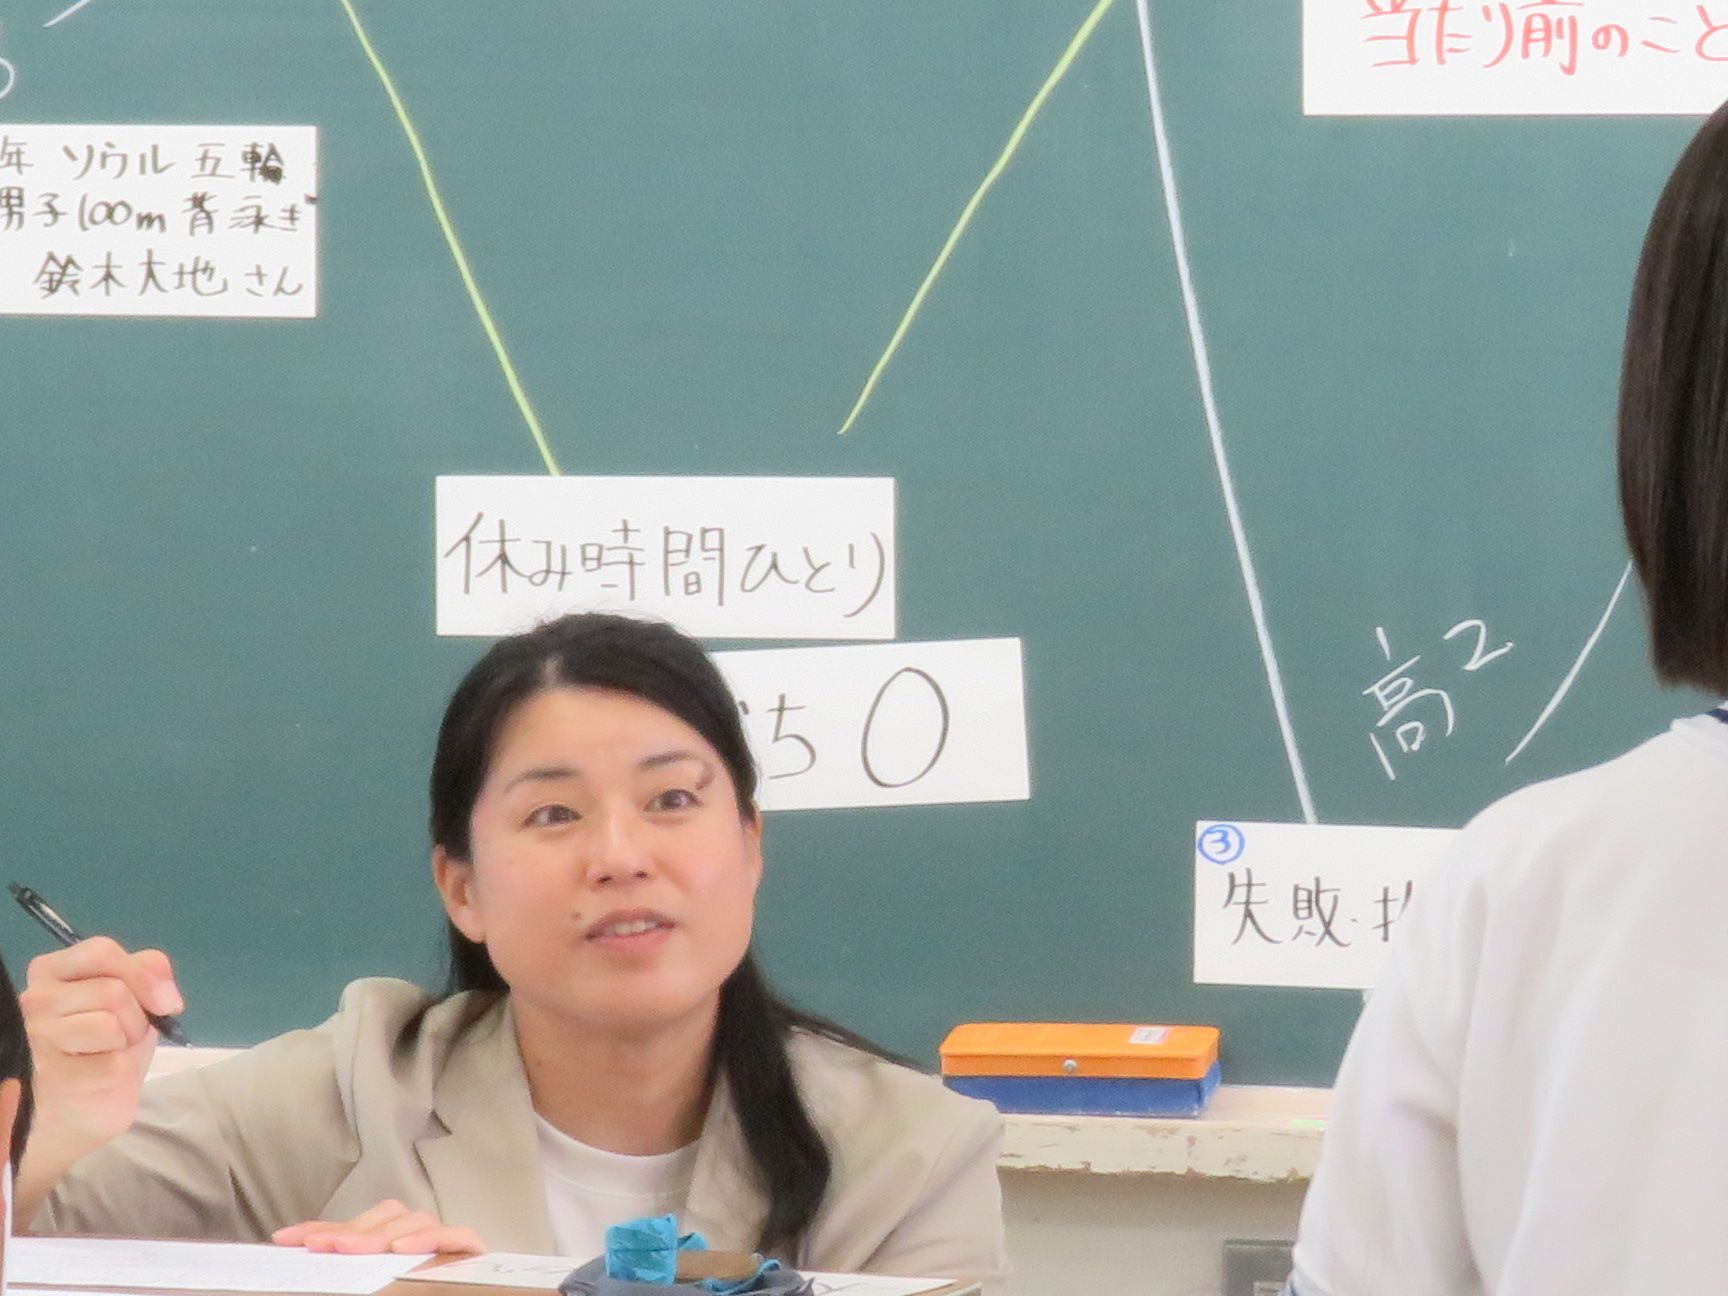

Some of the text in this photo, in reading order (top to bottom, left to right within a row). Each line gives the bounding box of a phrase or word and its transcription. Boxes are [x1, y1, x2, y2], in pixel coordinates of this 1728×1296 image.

[443, 511, 886, 618] 休み時間ひとり
[1362, 618, 1514, 781] 高2
